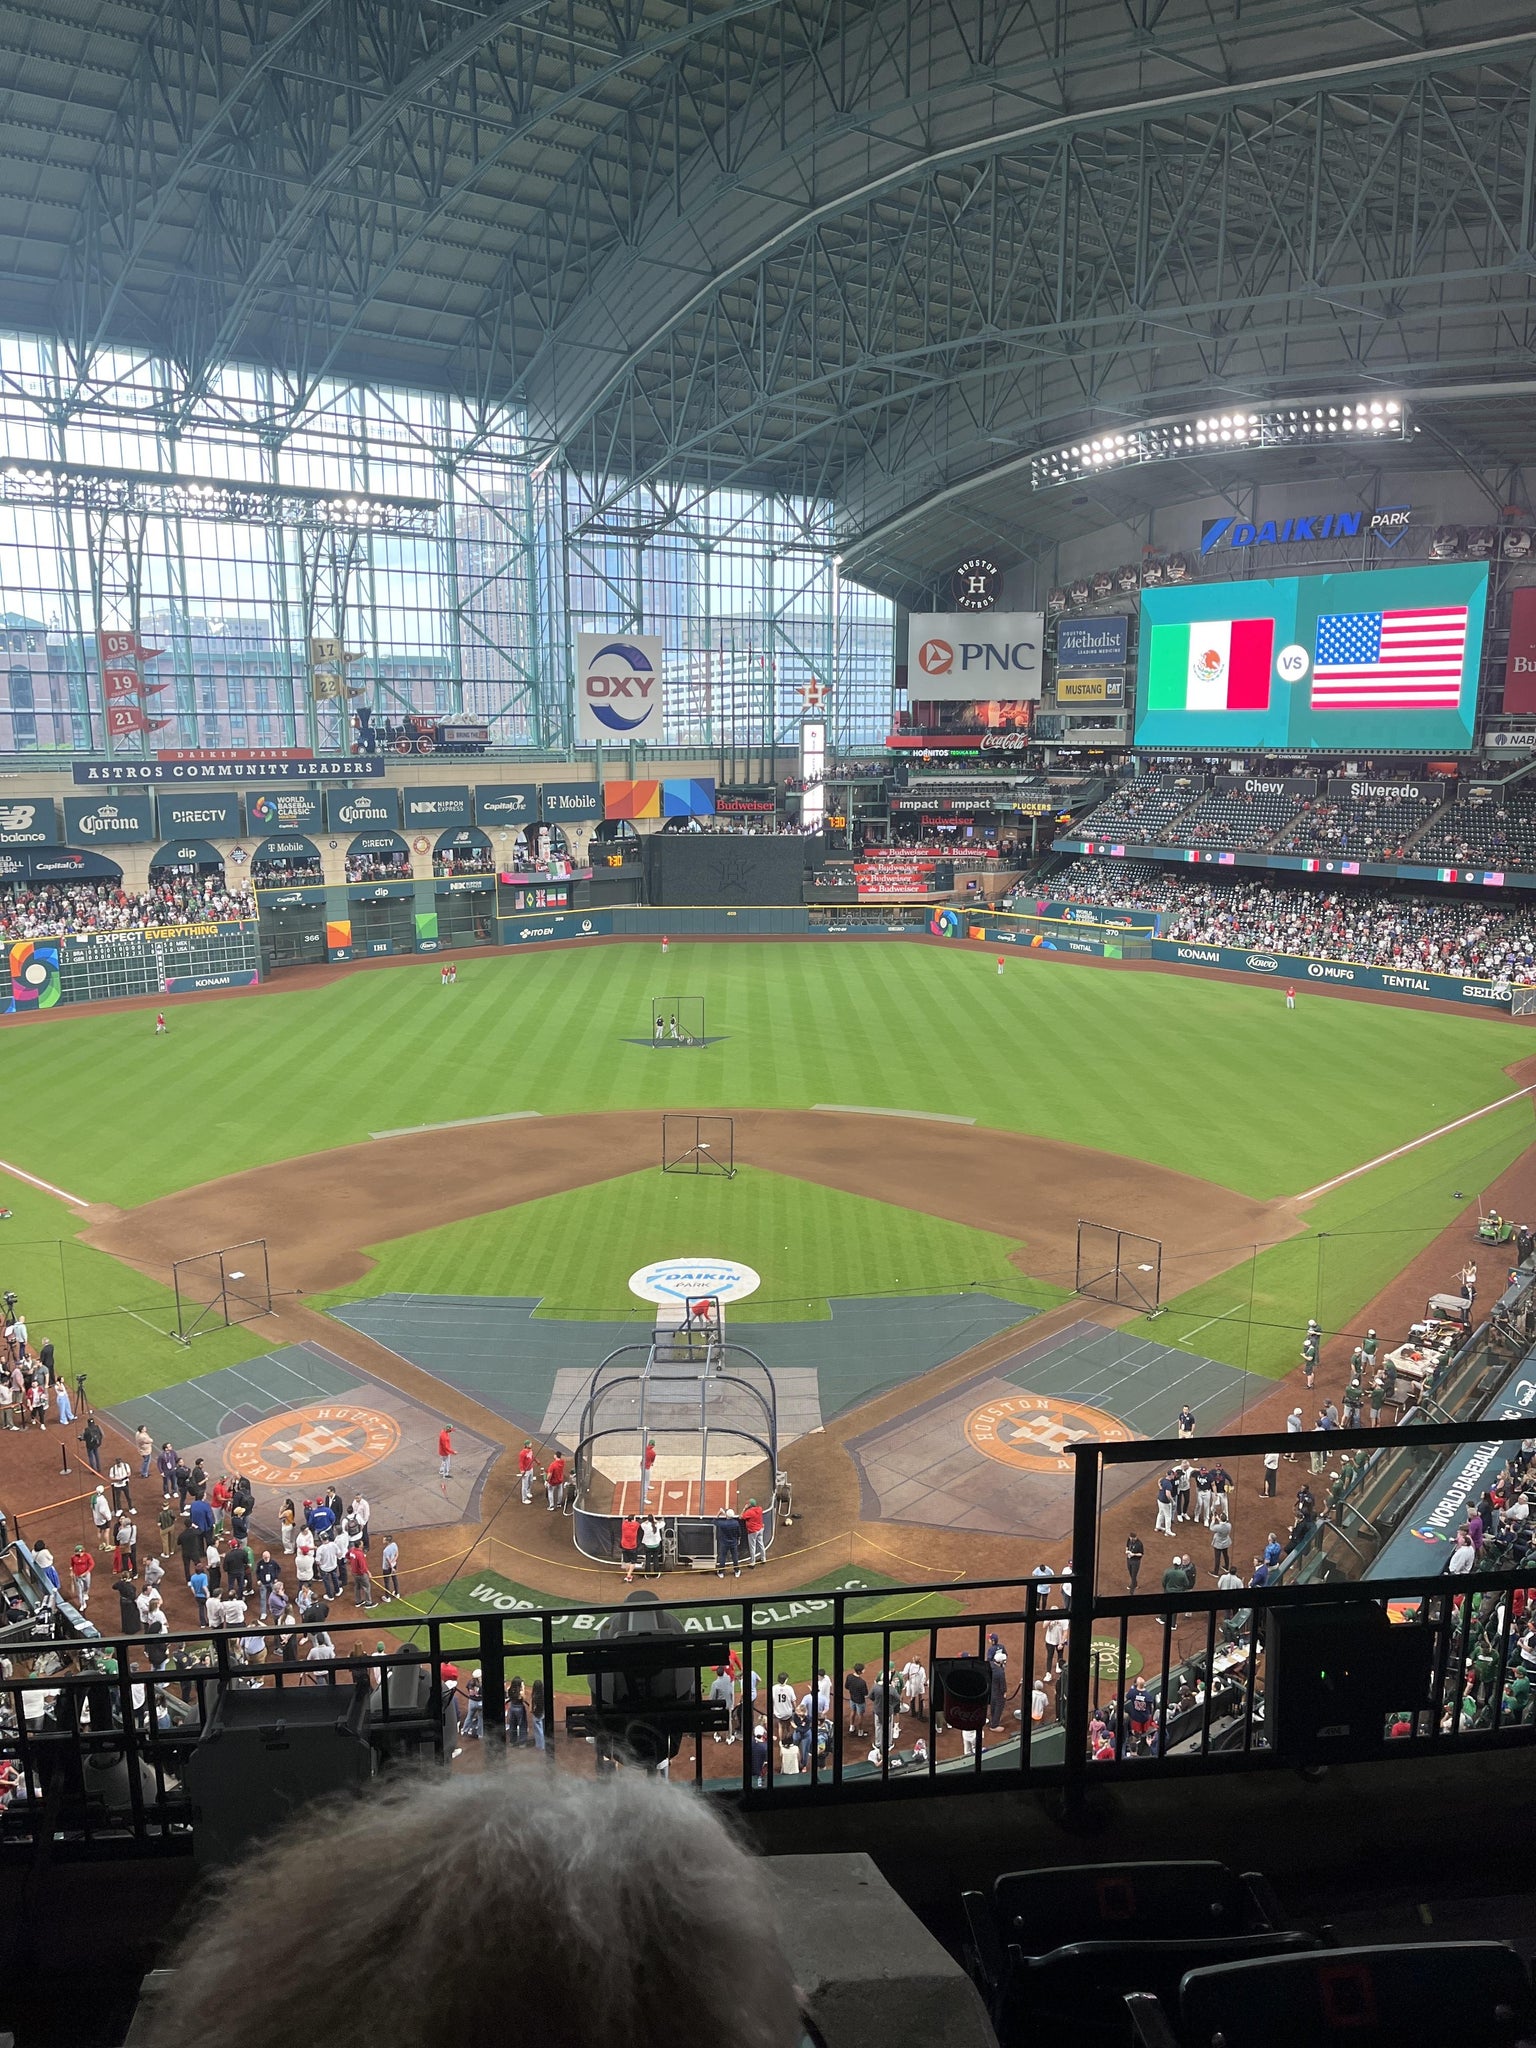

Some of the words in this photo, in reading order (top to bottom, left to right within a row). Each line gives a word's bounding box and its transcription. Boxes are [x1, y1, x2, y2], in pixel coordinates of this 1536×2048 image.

[1230, 512, 1362, 547] DAIKIN
[1370, 511, 1410, 527] PARK
[958, 559, 997, 575] HOUSTON
[968, 576, 986, 593] H
[958, 596, 994, 609] ASTROS
[108, 637, 129, 651] 05
[1063, 632, 1121, 649] Methodist
[318, 644, 335, 658] 17
[958, 642, 1036, 670] PNC
[1283, 657, 1302, 670] VS
[113, 676, 132, 690] 19
[320, 681, 336, 692] 22
[586, 677, 655, 697] OXY
[1066, 684, 1102, 695] MUSTANG
[1107, 683, 1121, 694] CAT
[115, 712, 134, 725] 21
[913, 749, 949, 757] HORNITOS
[88, 767, 163, 778] ASTROS
[173, 764, 289, 777] COMMUNITY
[298, 762, 373, 774] LEADERS
[1245, 780, 1284, 795] Chevy
[1350, 783, 1419, 798] Silverado
[277, 808, 311, 816] CLASSIC
[717, 799, 774, 811] Budweiser
[900, 800, 939, 810] impact
[952, 800, 991, 810] impact
[1012, 803, 1052, 811] PLUCKERS
[173, 810, 226, 822] DIRECTV
[339, 805, 388, 823] Corona
[921, 816, 974, 825] Budweiser
[79, 815, 139, 835] Corona
[1, 832, 46, 842] balance
[362, 838, 394, 848] DIRECTV
[178, 848, 197, 859] dip
[889, 848, 929, 856] Budweiser
[952, 849, 988, 857] Budweiser
[375, 887, 389, 897] dip
[96, 931, 143, 944] EXPECT
[145, 925, 218, 940] EVERYTHING
[530, 929, 543, 937] ITO
[1069, 942, 1092, 952] TENTIAL
[1178, 948, 1220, 962] KONAMI
[1249, 955, 1277, 970] Kowa
[1325, 967, 1354, 981] MUFG
[195, 976, 230, 987] KONAMI
[1382, 974, 1430, 991] TENTIAL
[1463, 985, 1512, 1002] SEIKO
[665, 1273, 742, 1281] DAIKIN
[975, 1400, 1049, 1441] HOUSTON
[317, 1409, 388, 1451] HOUSTON
[232, 1441, 301, 1481] ASTROS
[1426, 1489, 1466, 1528] WORLD
[1452, 1444, 1500, 1492] BASEBALL
[469, 1583, 569, 1625] WOR
[778, 1694, 787, 1703] 19
